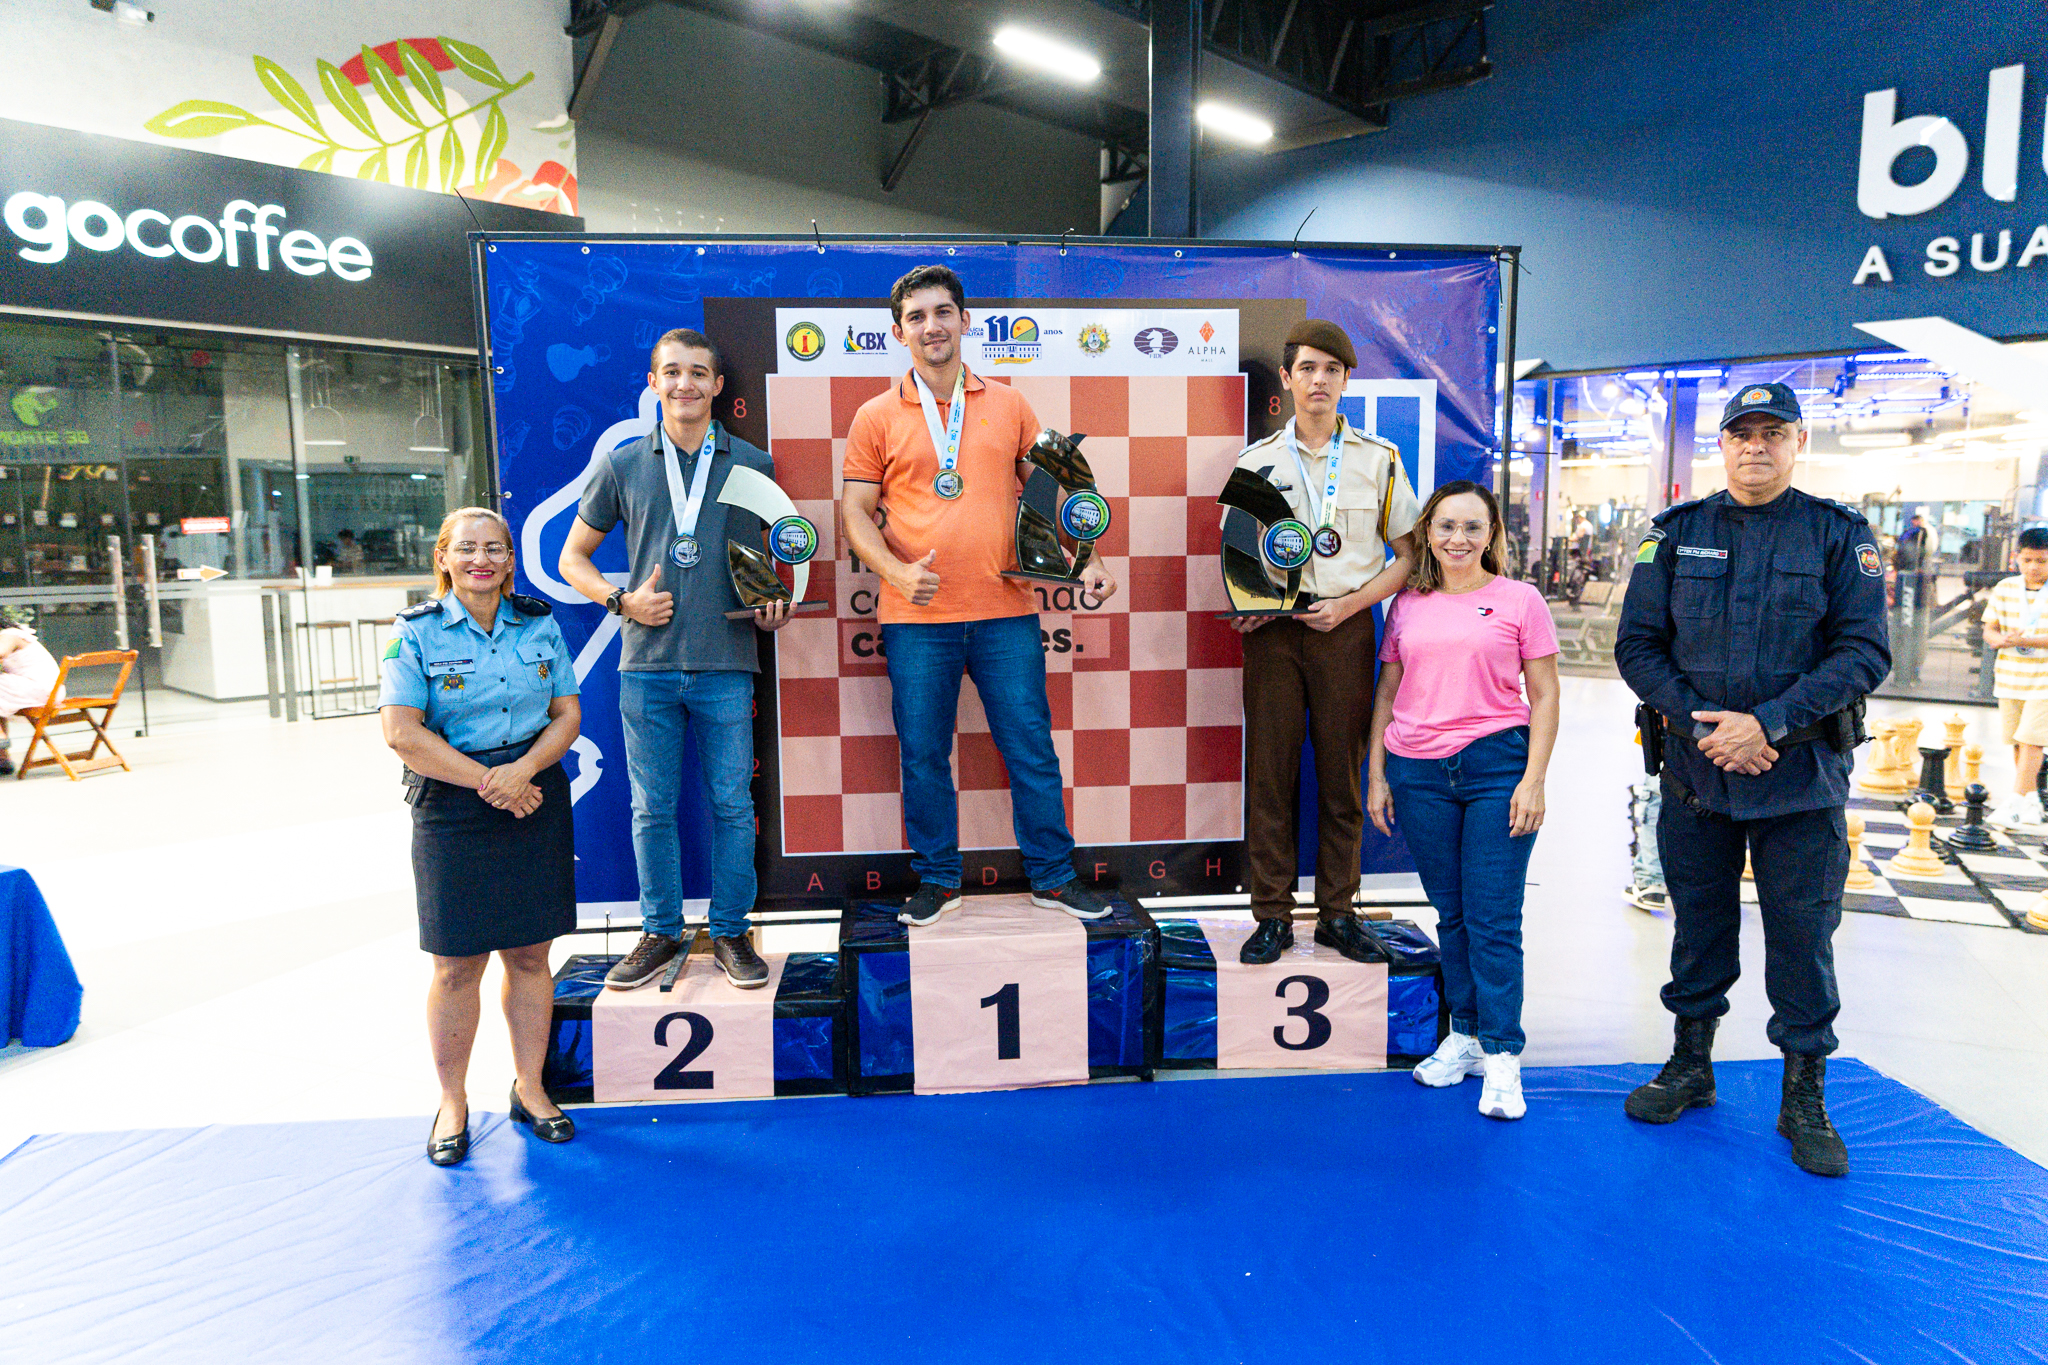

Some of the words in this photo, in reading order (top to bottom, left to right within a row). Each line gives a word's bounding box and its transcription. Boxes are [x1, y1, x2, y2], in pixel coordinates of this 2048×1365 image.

[1857, 63, 2048, 219] bl
[4, 190, 374, 281] gocoffee
[1852, 245, 1893, 284] A
[1923, 224, 2048, 277] SUA
[856, 332, 887, 350] CBX
[1188, 346, 1226, 355] ALPHA
[734, 398, 747, 418] 8
[1269, 396, 1281, 416] 8
[807, 872, 824, 891] A
[866, 871, 881, 890] B
[982, 867, 998, 886] D
[1095, 862, 1108, 881] F
[1149, 860, 1166, 879] G
[1206, 858, 1221, 877] H
[980, 983, 1021, 1060] 1
[1273, 974, 1332, 1051] 3
[653, 1011, 714, 1090] 2
